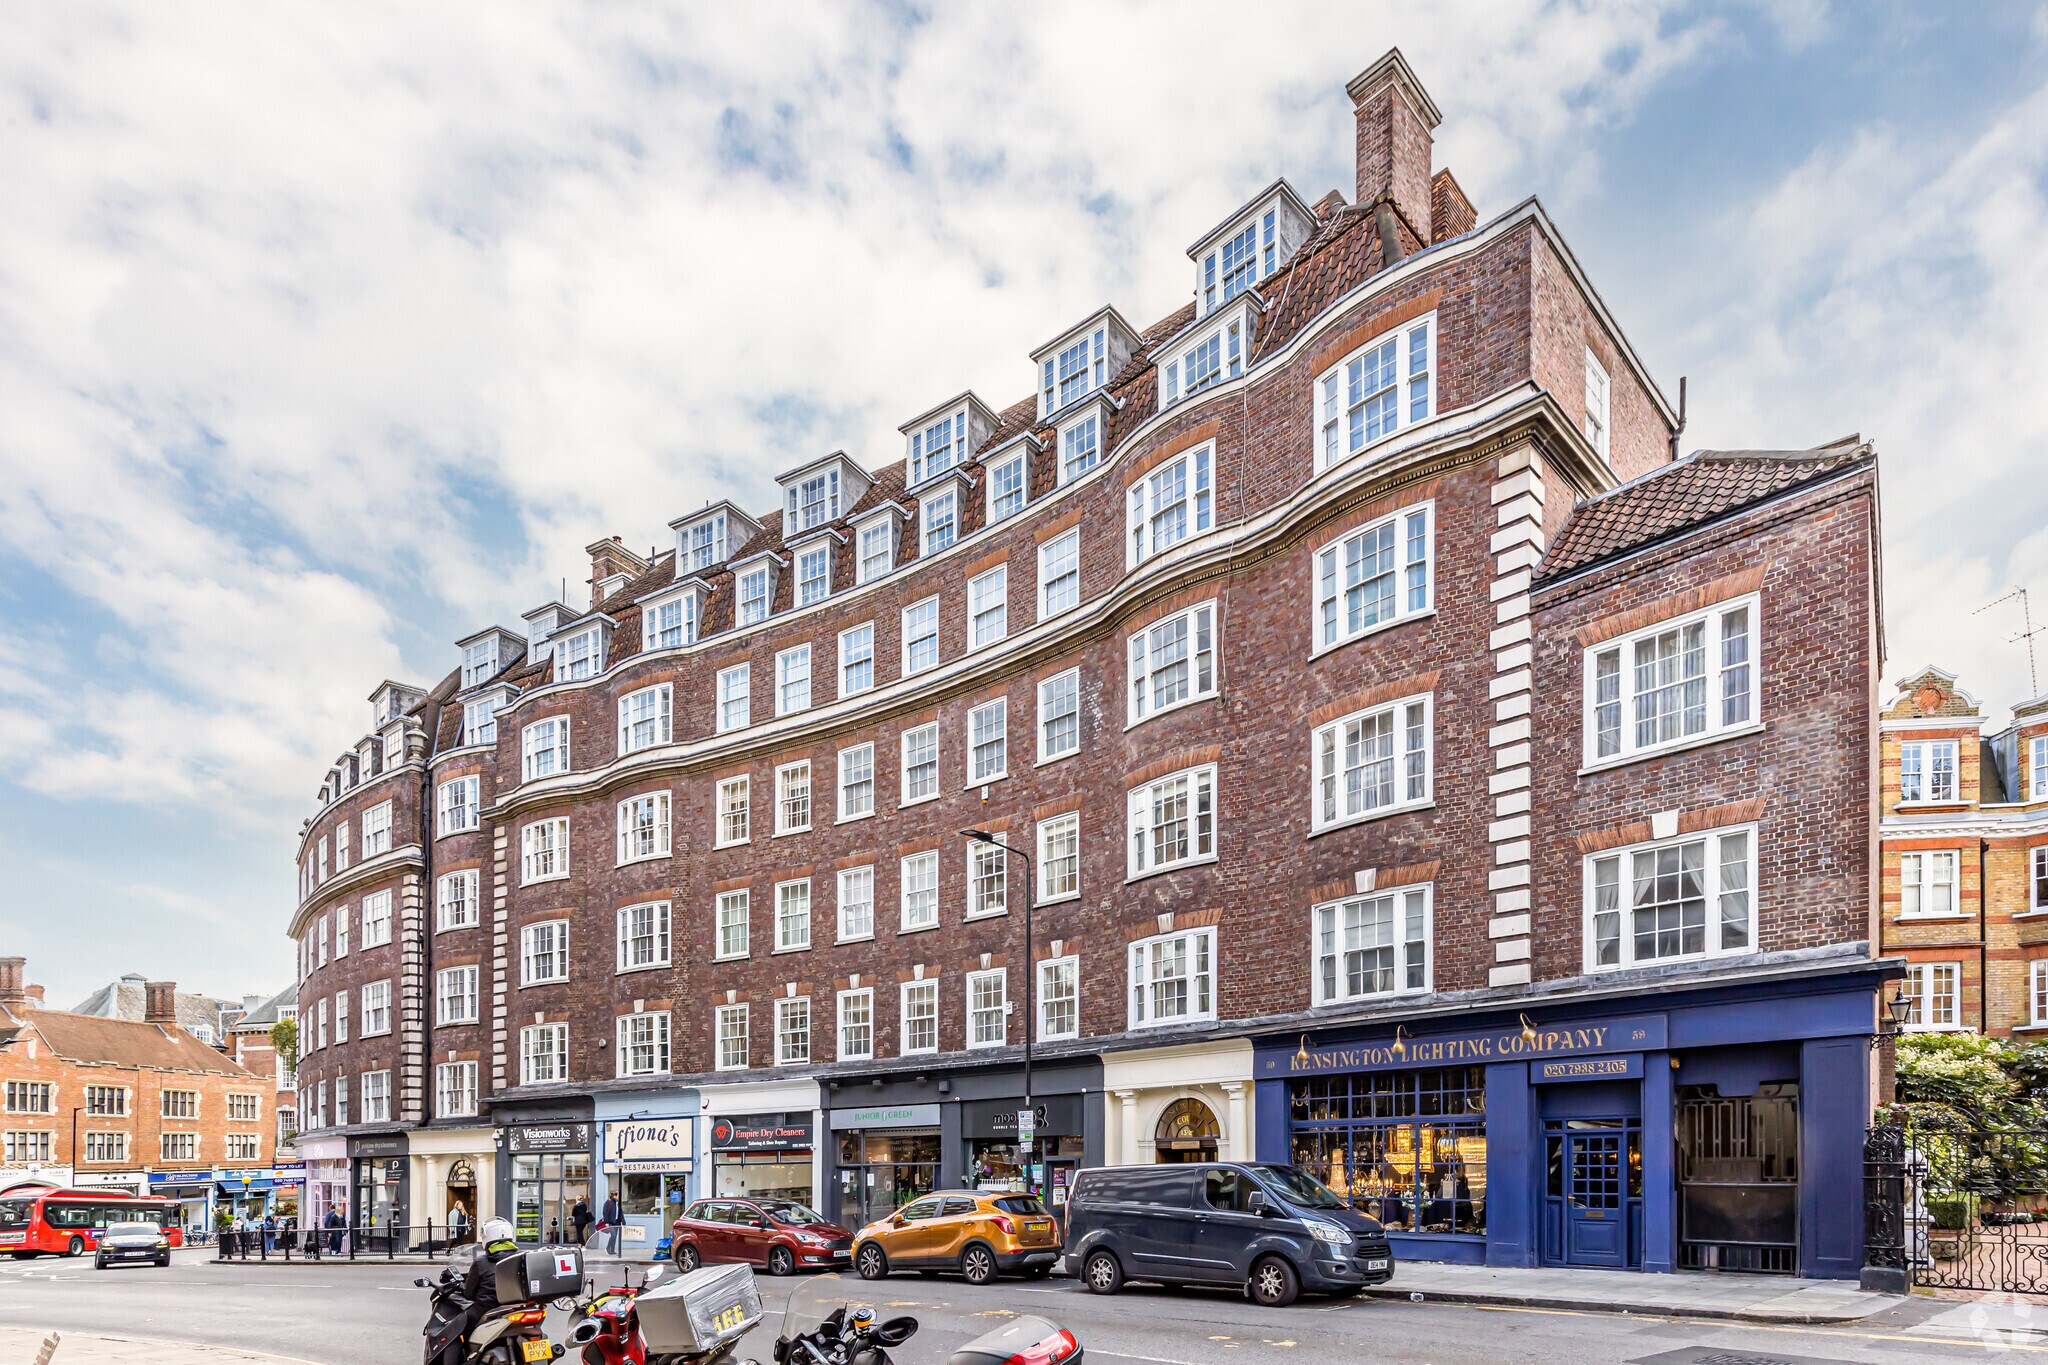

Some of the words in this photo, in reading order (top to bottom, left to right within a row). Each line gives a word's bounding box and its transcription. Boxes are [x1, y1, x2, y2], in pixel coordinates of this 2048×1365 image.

[1632, 1029, 1646, 1041] 59
[1290, 1047, 1393, 1071] KENSINGTON
[1401, 1037, 1491, 1063] LIGHTING
[1498, 1027, 1608, 1055] COMPANY
[1545, 1065, 1566, 1076] 020
[1568, 1063, 1595, 1075] 7938
[855, 1112, 880, 1121] JUNIOR
[888, 1110, 913, 1119] GREEN
[522, 1126, 571, 1139] Visionworks
[735, 1128, 759, 1140] Empire
[760, 1128, 774, 1139] Dry
[775, 1127, 805, 1137] Cleaners
[615, 1124, 680, 1155] ffiona's
[624, 1163, 670, 1171] RESTAURANT
[4, 1213, 15, 1221] 70
[560, 1259, 572, 1272] L
[527, 1341, 547, 1351] AP16
[529, 1349, 548, 1358] PYX
